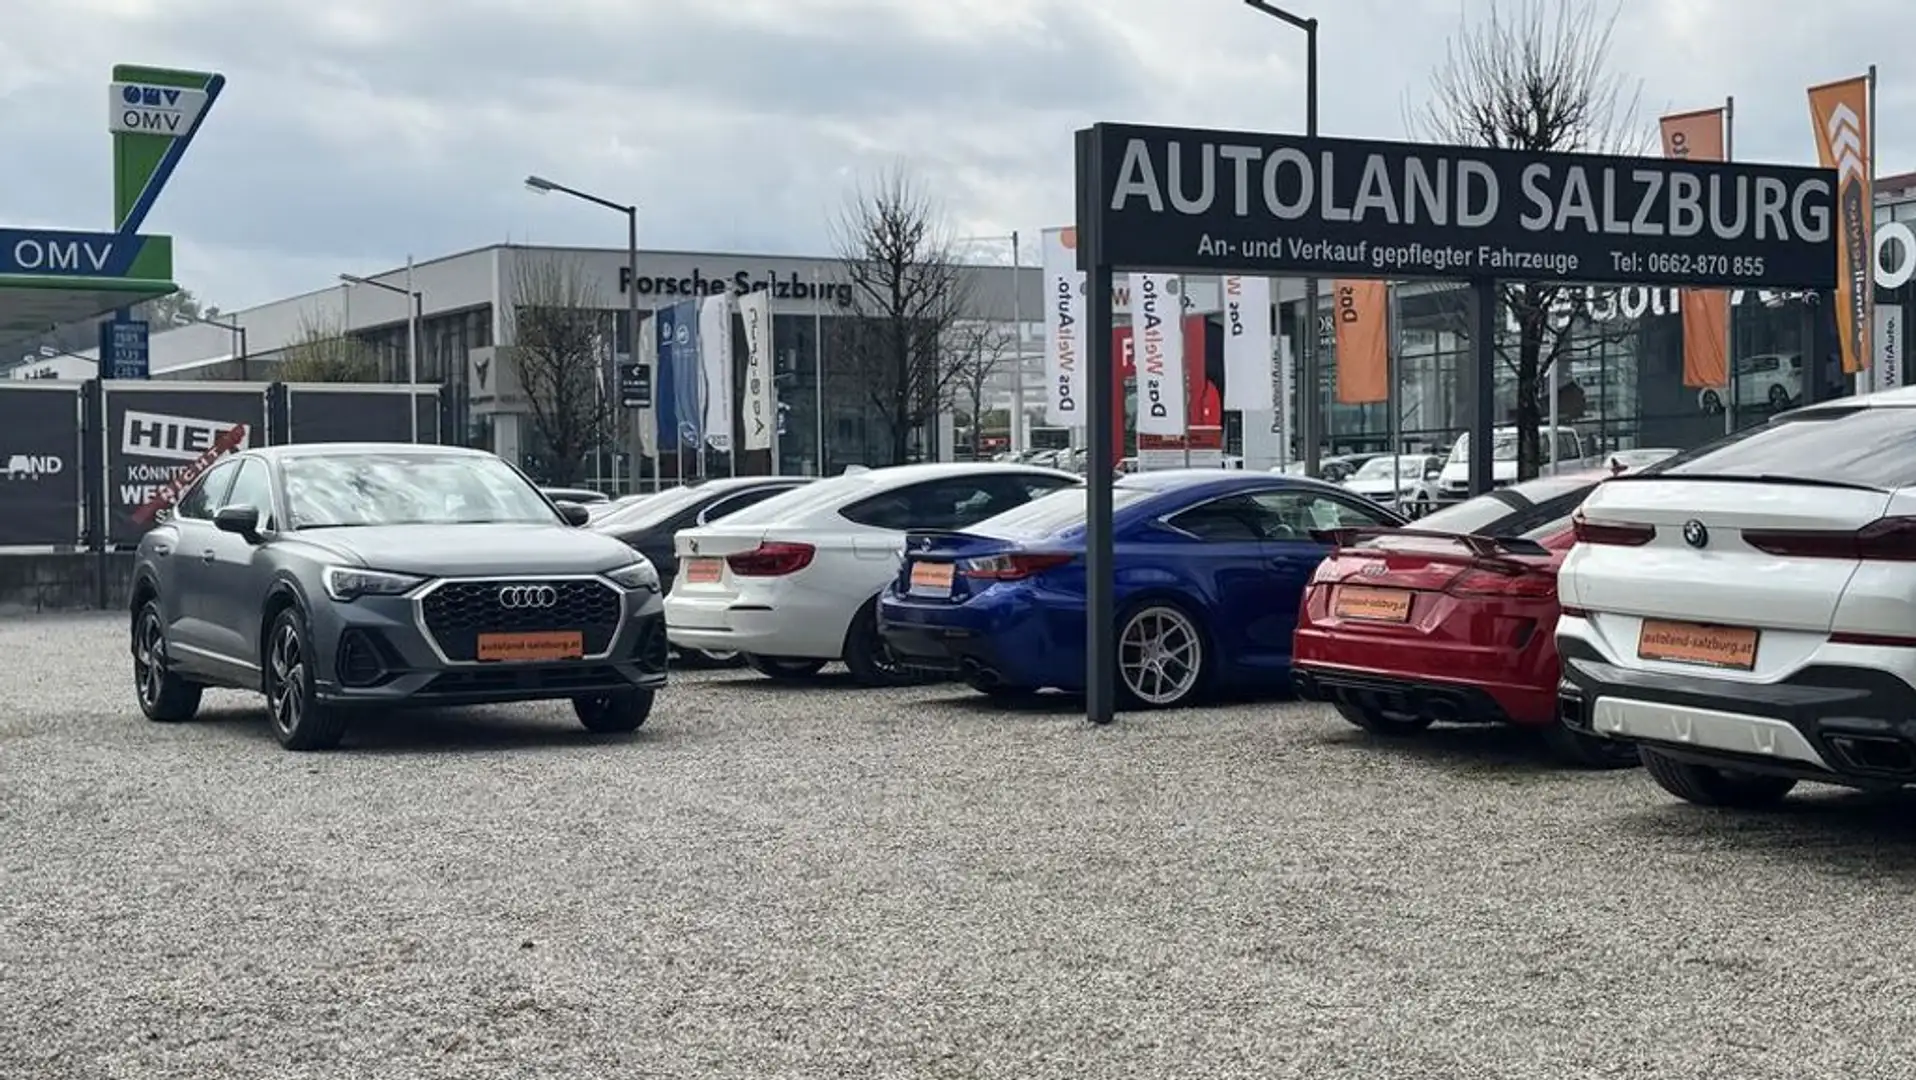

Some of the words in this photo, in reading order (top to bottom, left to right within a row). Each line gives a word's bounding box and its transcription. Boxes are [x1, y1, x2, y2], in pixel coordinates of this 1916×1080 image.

[123, 110, 181, 131] OMV
[1111, 138, 1499, 227] AUTOLAND
[1520, 162, 1831, 243] SALZBURG
[14, 239, 113, 271] OMV
[1198, 234, 1236, 258] An-
[1242, 237, 1282, 260] und
[1288, 239, 1366, 263] Verkauf
[1372, 243, 1473, 270] gepflegter
[1478, 246, 1579, 275] Fahrzeuge
[1611, 252, 1643, 273] Tel:
[1648, 253, 1728, 277] 0662-870
[1733, 257, 1764, 277] 855
[619, 267, 726, 297] Porsche
[734, 270, 854, 308] Salzburg
[1643, 632, 1753, 656] autoland-salzburg.at
